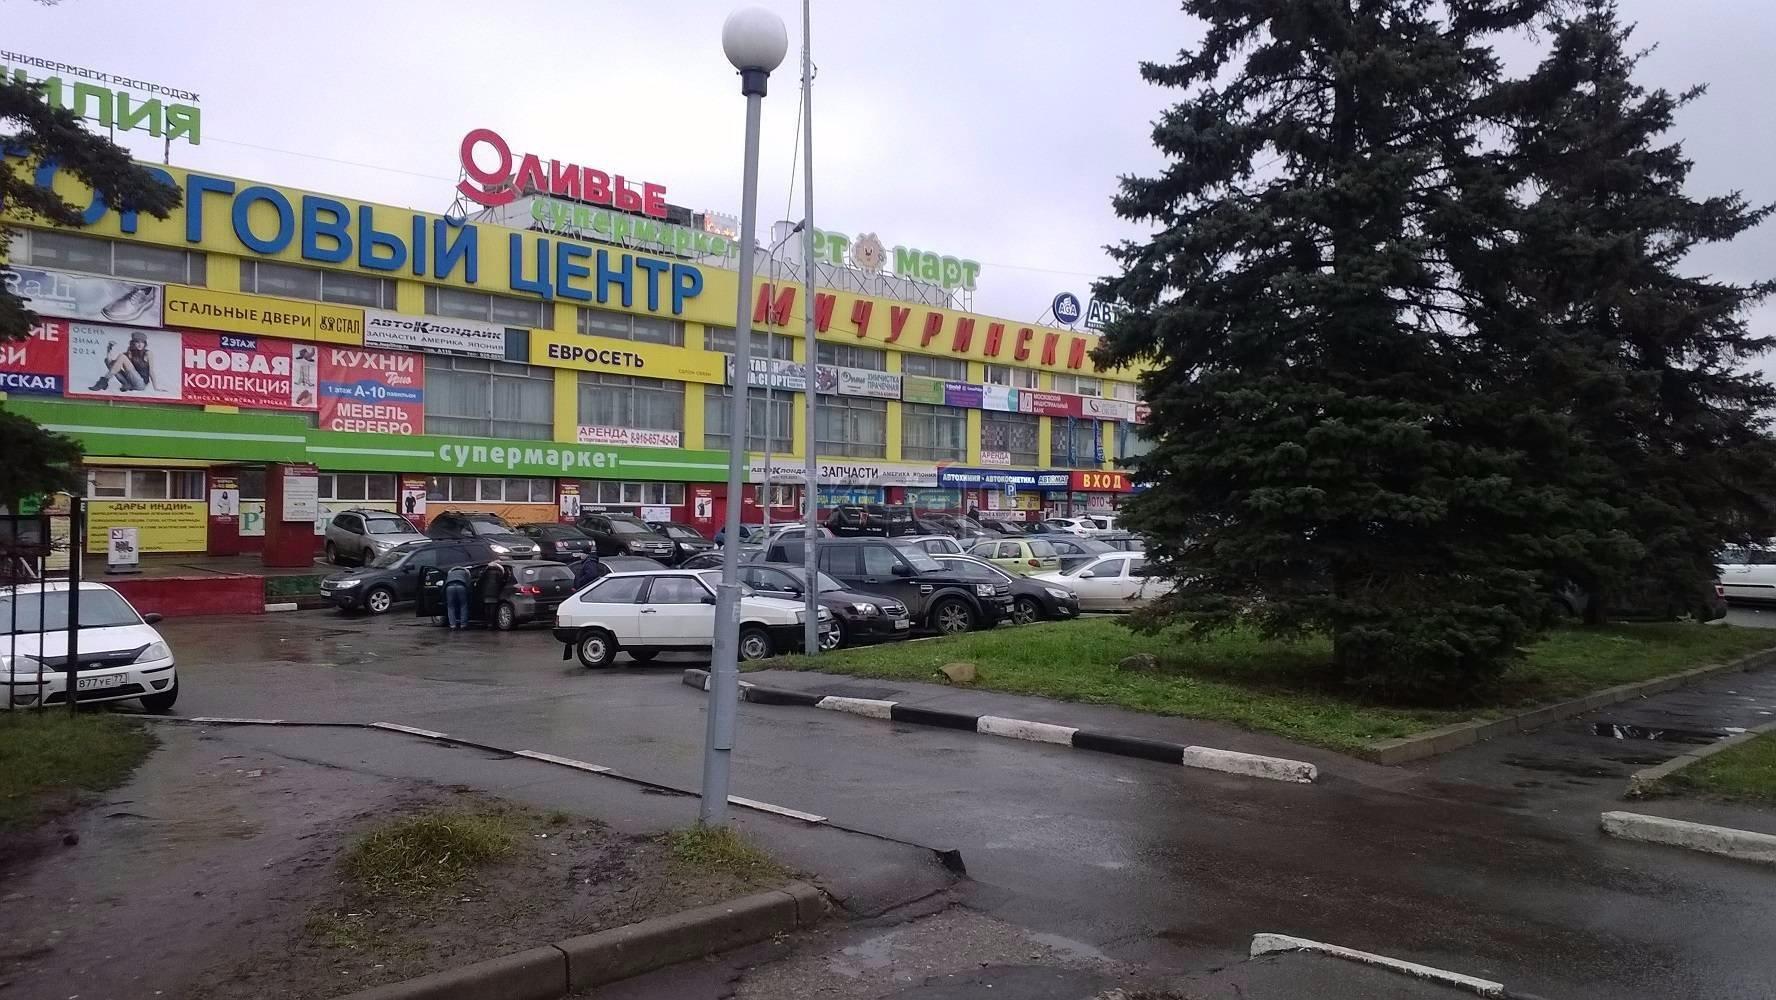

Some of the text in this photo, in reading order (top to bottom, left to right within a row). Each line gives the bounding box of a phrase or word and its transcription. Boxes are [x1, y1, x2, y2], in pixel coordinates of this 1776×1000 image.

[1, 50, 200, 103] универмаги распродаж
[509, 233, 703, 315] ЦЕНТР
[168, 299, 311, 328] СТАЛЬНЫЕ ДВЕРИ
[72, 326, 105, 337] ОСЕНЬ
[753, 282, 1107, 372] МИЧУРИНСКИ
[72, 336, 100, 346] ЗИМА
[367, 330, 416, 342] ЗАПЧАСТИ
[421, 336, 463, 347] АМЕРИКА
[467, 341, 503, 352] ЯПОНИЯ
[72, 347, 96, 357] 2014
[184, 348, 290, 374] НОВАЯ
[331, 349, 414, 373] КУХНИ
[547, 343, 645, 369] ЕВРОСЕТЬ
[184, 373, 289, 396] КОЛЛЕКЦИЯ
[1033, 394, 1062, 402] МОСКОВСКИЙ
[337, 402, 408, 421] МЕБЕЛЬ
[331, 418, 413, 436] СЕРЕБРО
[579, 427, 629, 442] АРЕНДА
[439, 443, 618, 471] супермаркет
[822, 465, 879, 479] ЗАПЧАСТИ
[942, 473, 1035, 484] АВТОХИМИЯ АВТОКОСМЕТИКА
[1083, 473, 1122, 489] ВХОД
